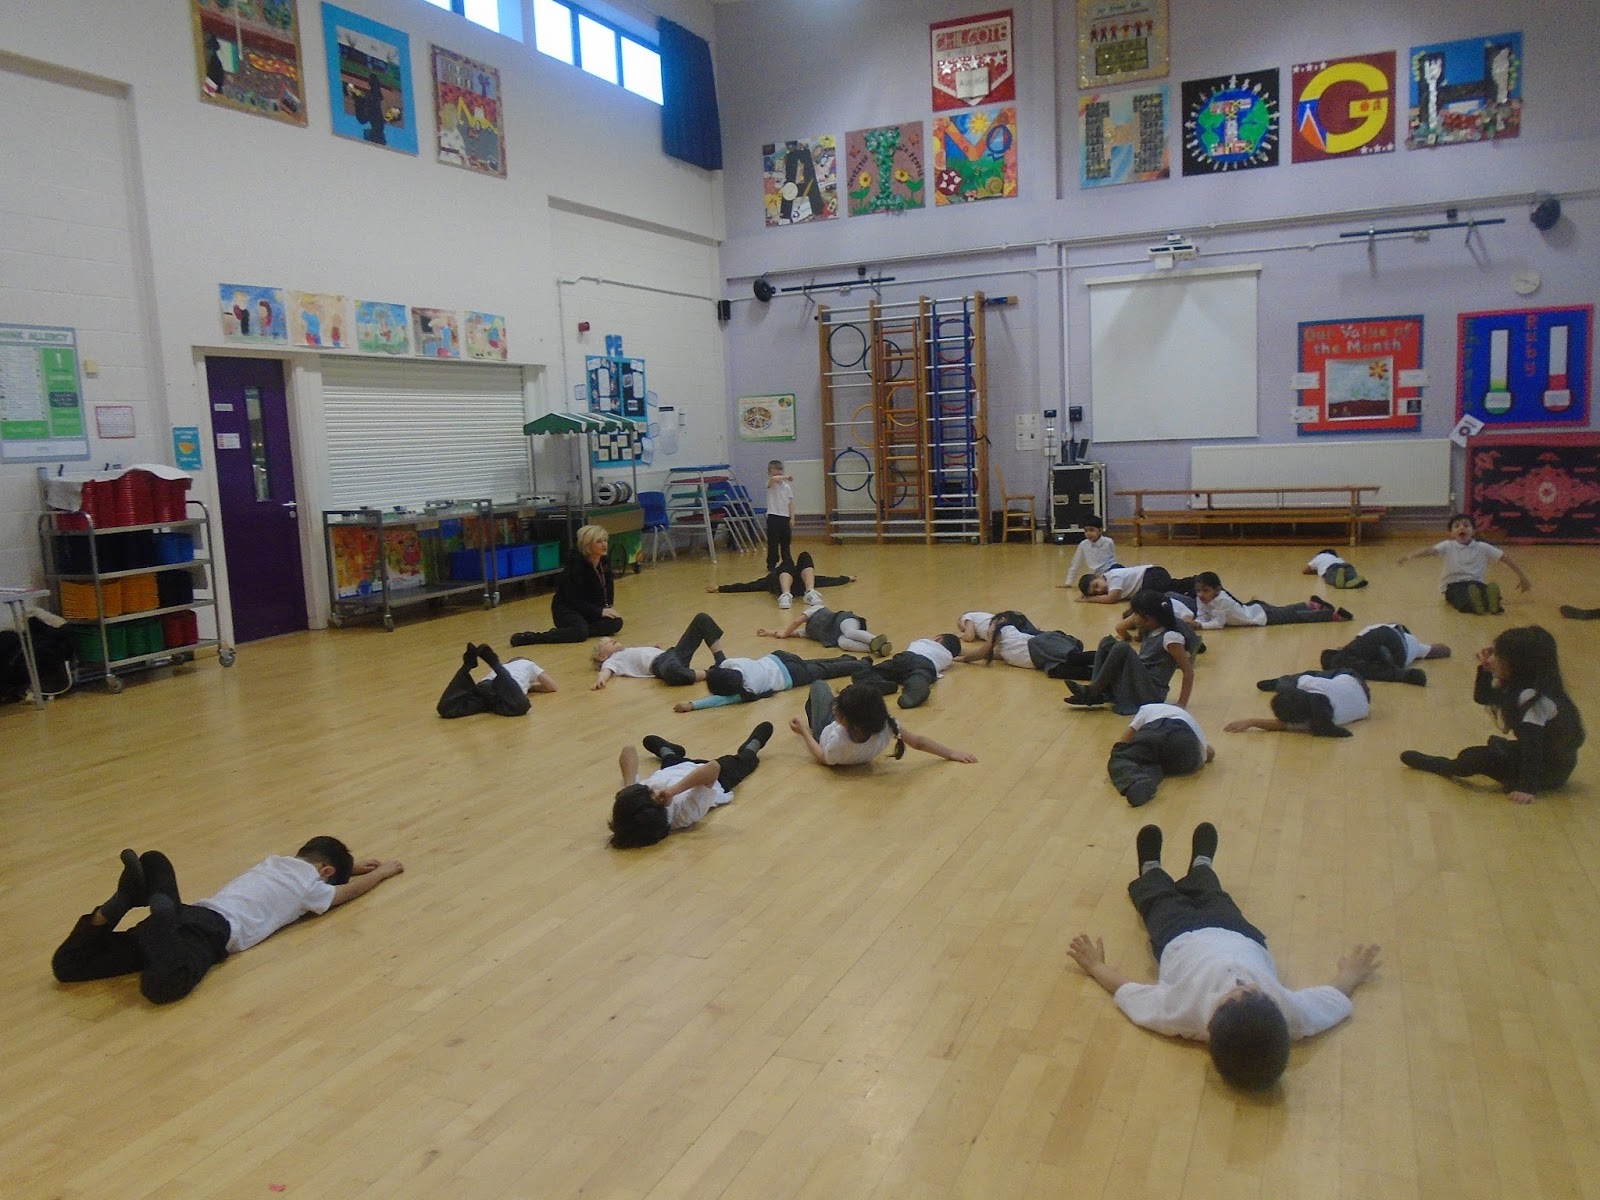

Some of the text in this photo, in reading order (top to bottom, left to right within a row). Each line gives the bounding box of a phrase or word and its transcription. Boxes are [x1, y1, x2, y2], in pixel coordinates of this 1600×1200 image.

[1297, 62, 1389, 154] G
[1304, 323, 1413, 341] Our Value of
[1314, 338, 1402, 354] the Month
[1525, 314, 1538, 377] Ruby
